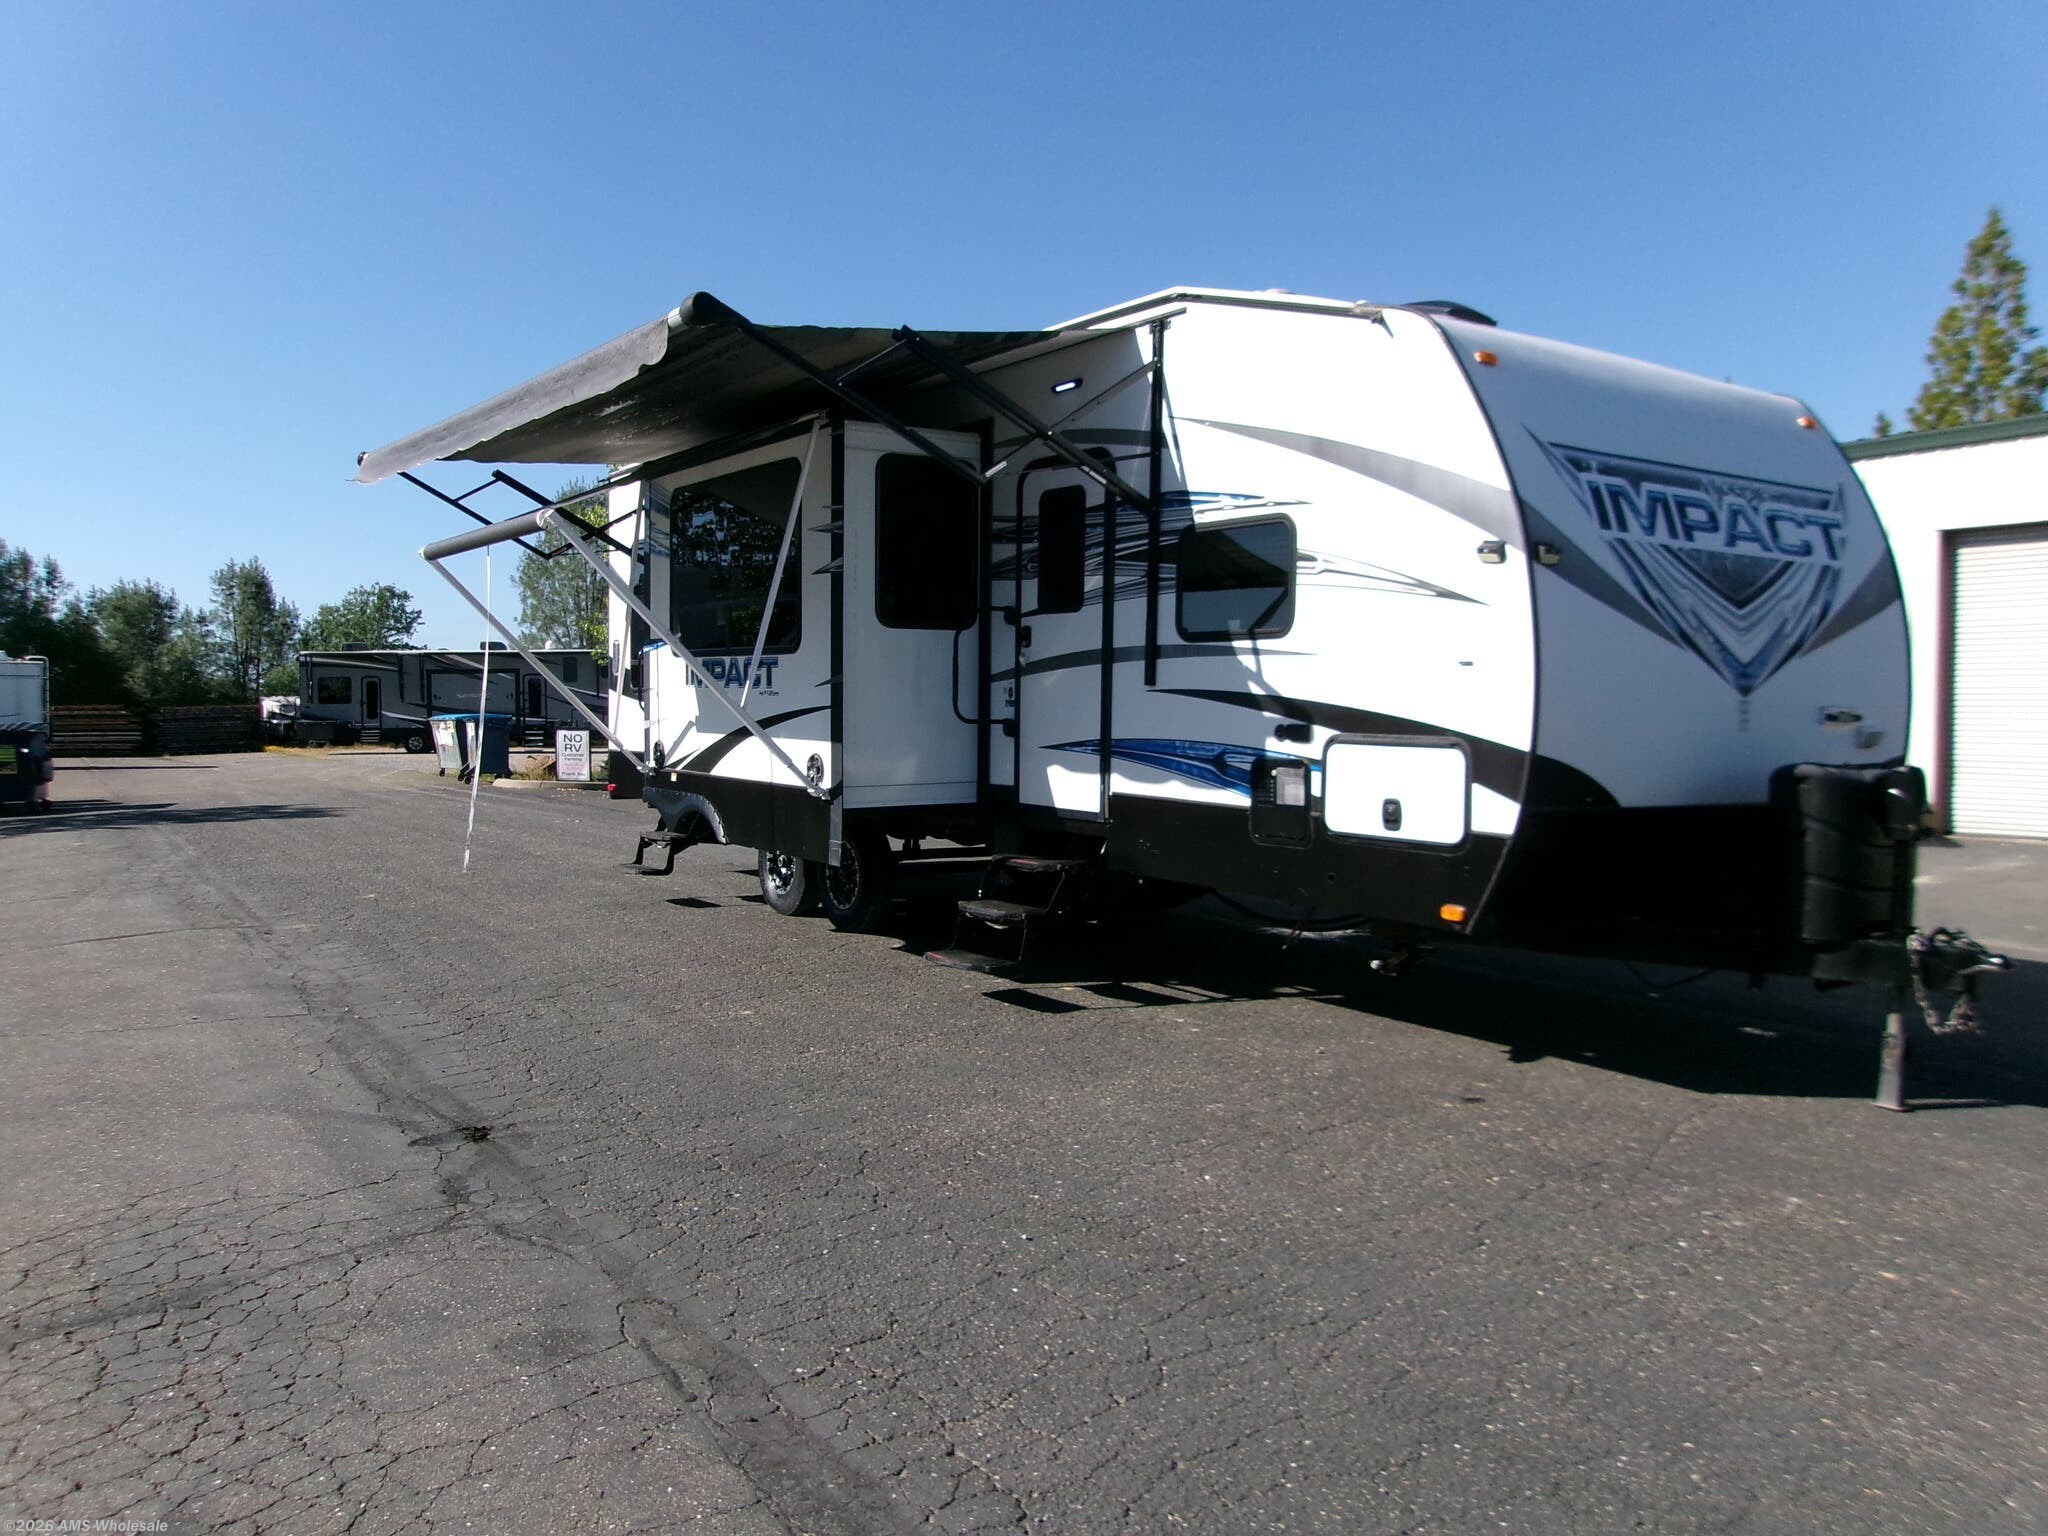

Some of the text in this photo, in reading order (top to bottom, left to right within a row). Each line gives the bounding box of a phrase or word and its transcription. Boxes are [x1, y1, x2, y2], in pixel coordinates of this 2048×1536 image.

[1581, 476, 1843, 561] IMPACT
[564, 733, 583, 743] NO
[564, 744, 582, 752] RV
